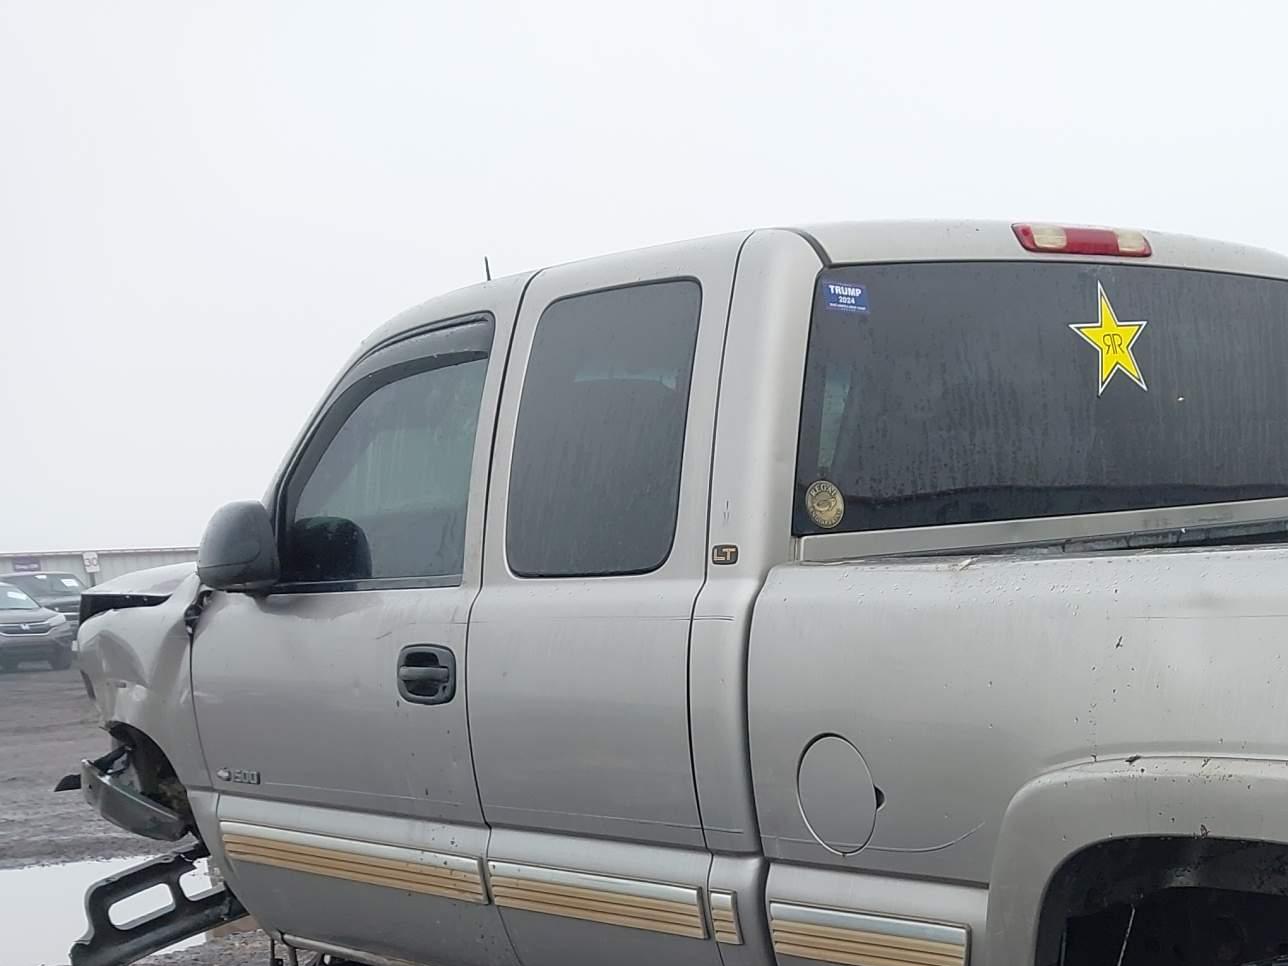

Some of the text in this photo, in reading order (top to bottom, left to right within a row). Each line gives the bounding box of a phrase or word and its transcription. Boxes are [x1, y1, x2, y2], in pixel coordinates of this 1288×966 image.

[828, 284, 862, 297] TRUMP
[838, 296, 856, 304] 2024
[713, 547, 737, 561] LT
